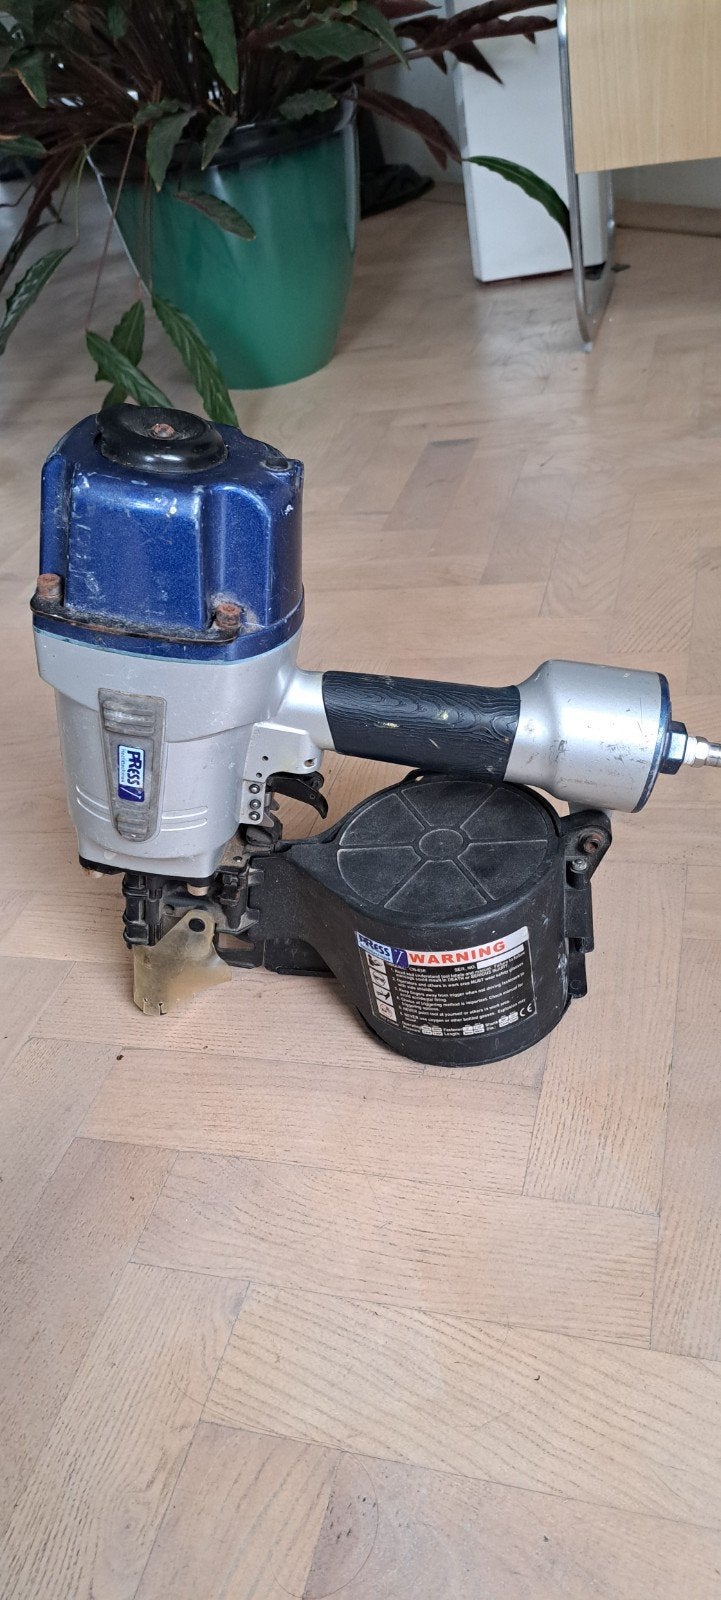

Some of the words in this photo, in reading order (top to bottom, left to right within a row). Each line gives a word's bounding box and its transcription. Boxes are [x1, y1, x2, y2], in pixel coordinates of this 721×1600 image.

[127, 750, 142, 785] PRESS
[359, 935, 390, 956] PRESS
[409, 941, 505, 964] WARNING
